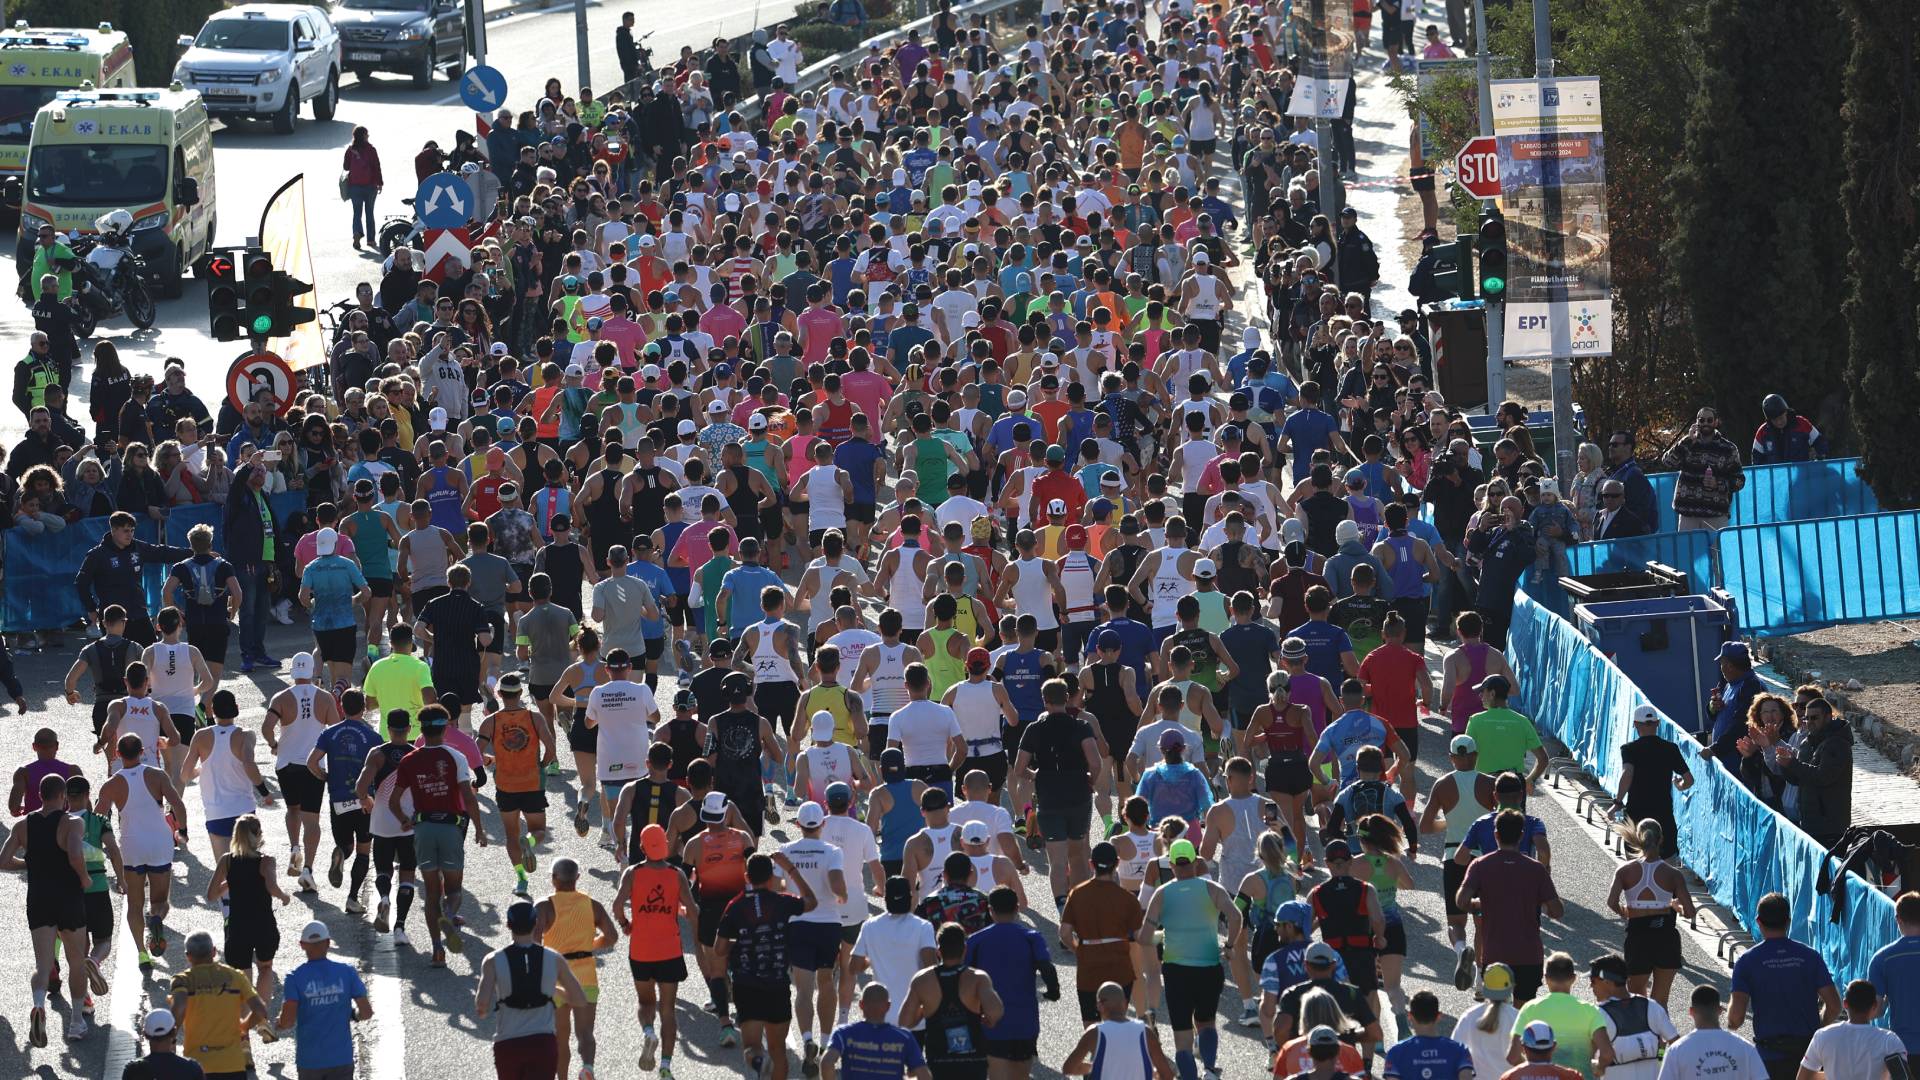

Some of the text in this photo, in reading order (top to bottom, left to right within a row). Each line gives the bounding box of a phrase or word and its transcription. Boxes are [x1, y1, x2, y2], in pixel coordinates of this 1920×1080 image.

[1462, 153, 1499, 184] STO
[1518, 316, 1548, 330] ΕΡΤ
[438, 366, 461, 382] GAP
[165, 650, 176, 677] Runna
[310, 994, 340, 1007] ITALIA
